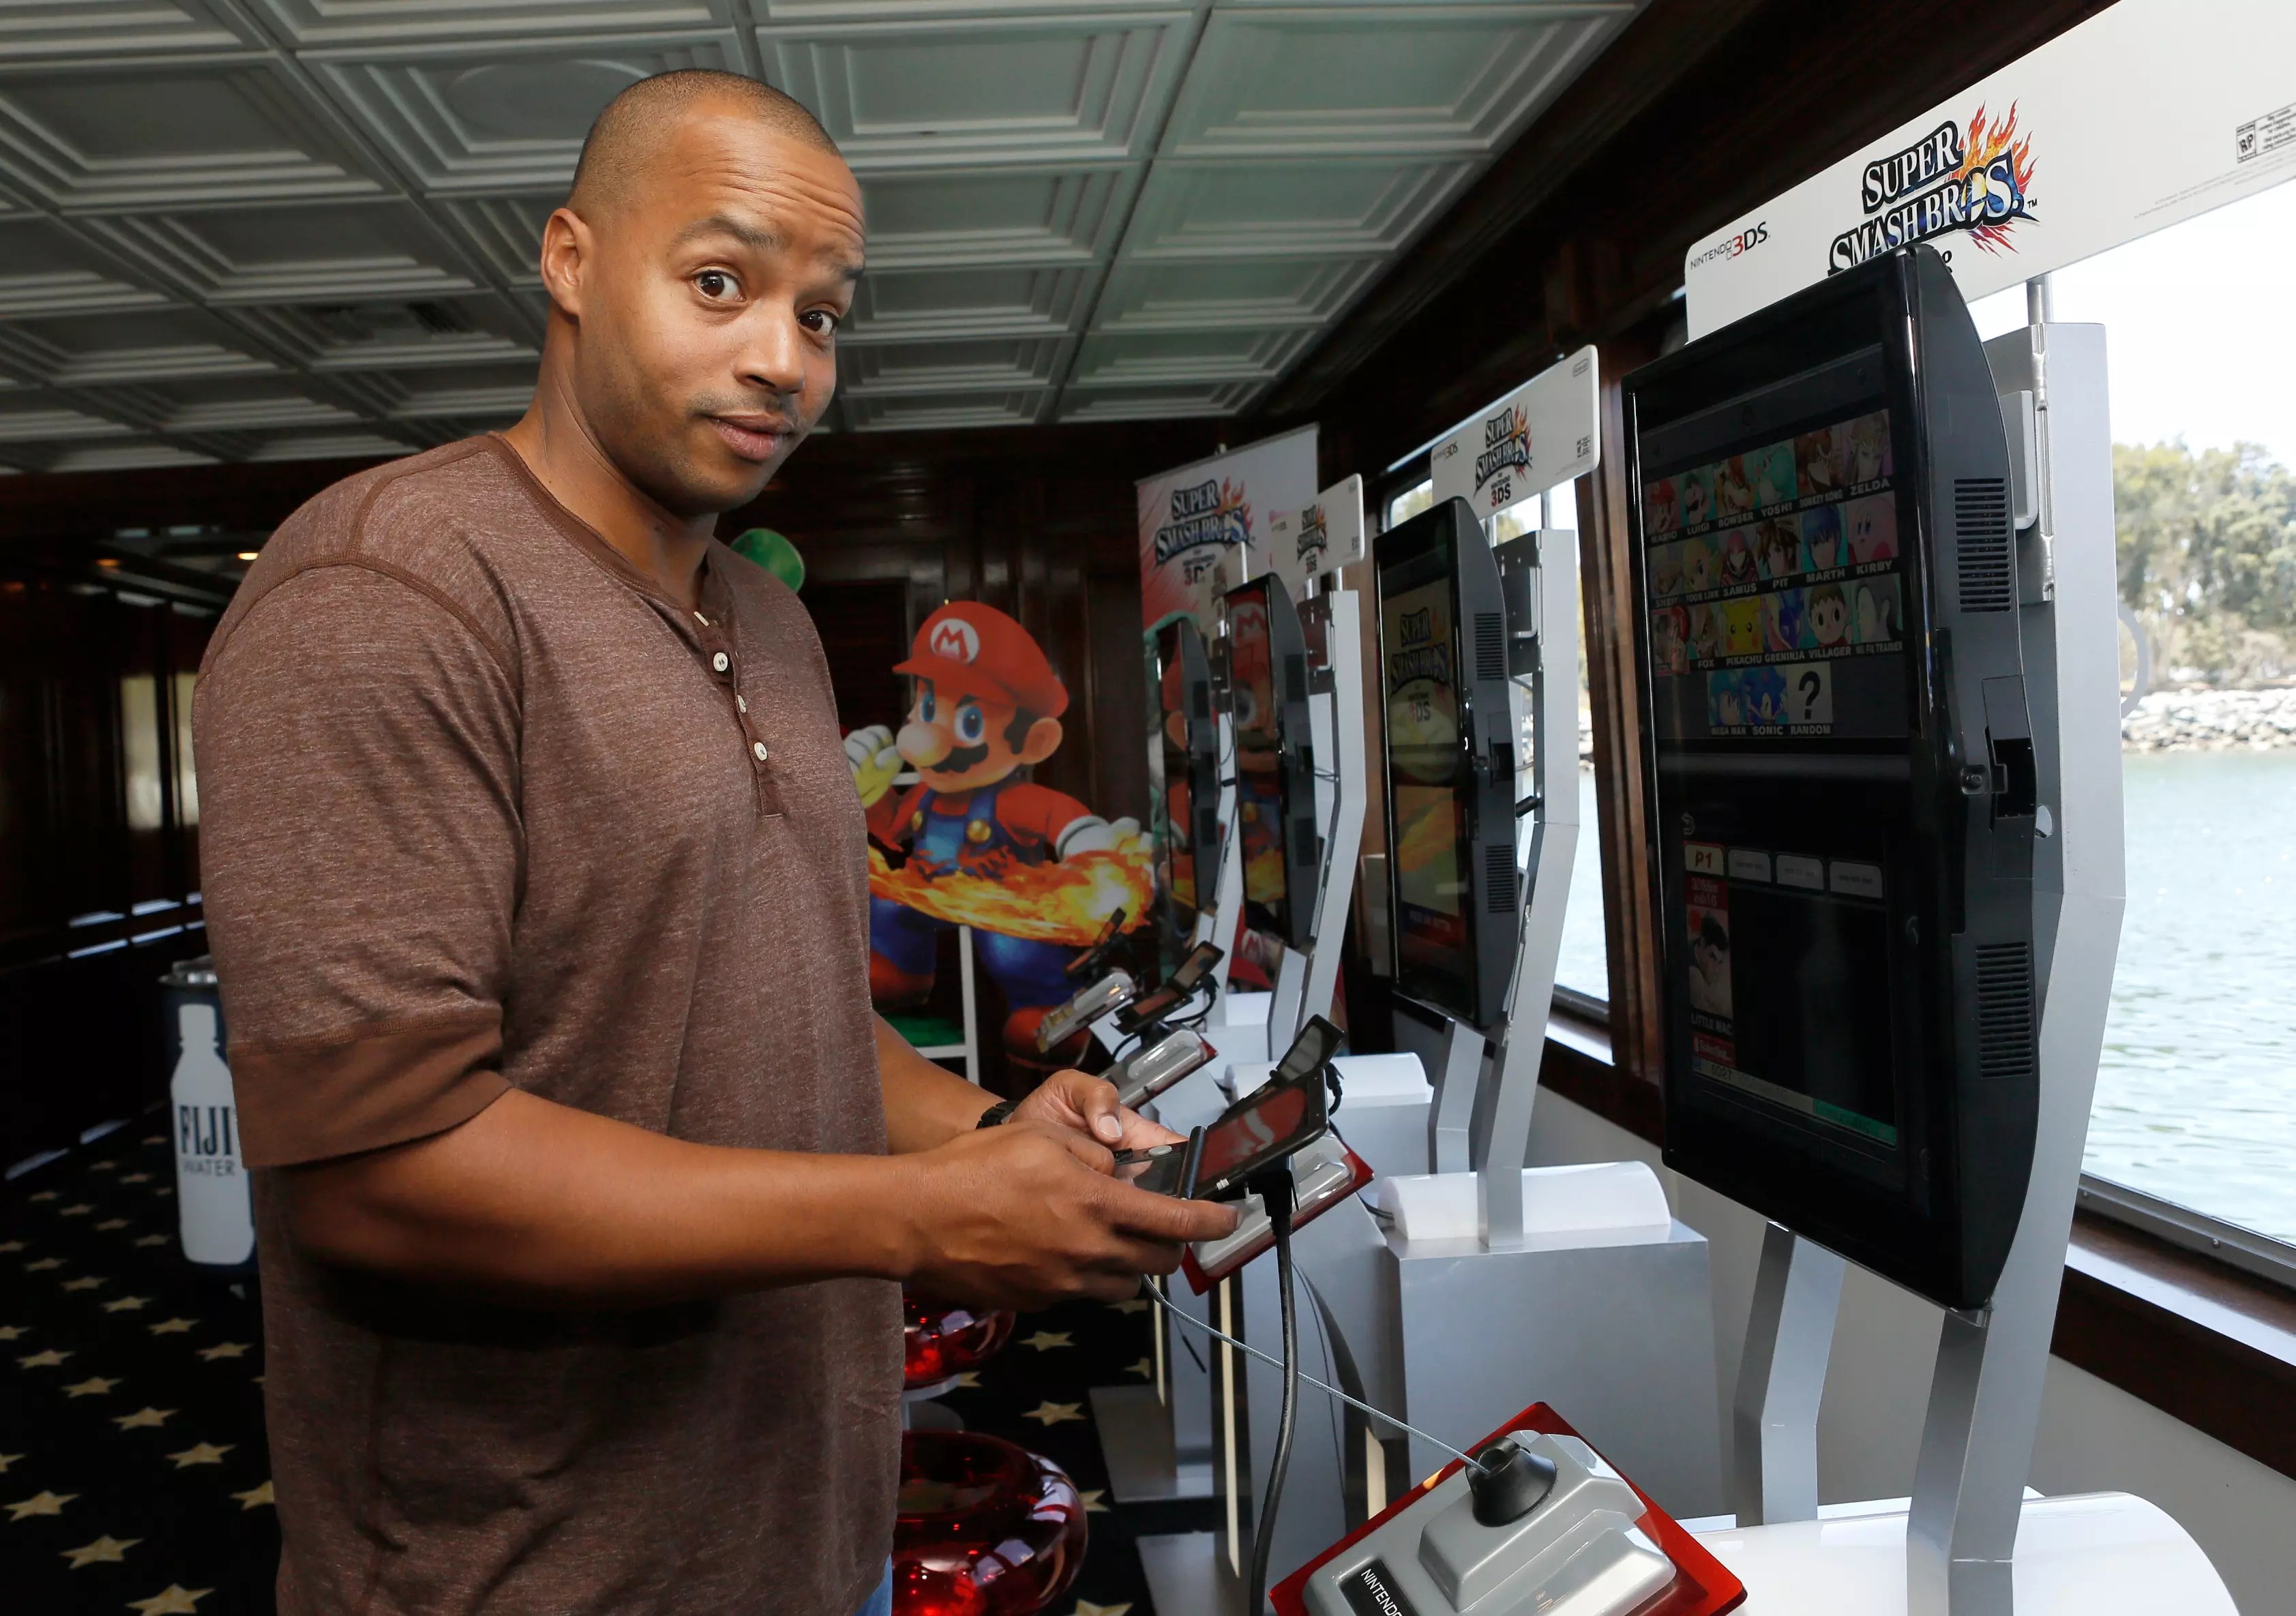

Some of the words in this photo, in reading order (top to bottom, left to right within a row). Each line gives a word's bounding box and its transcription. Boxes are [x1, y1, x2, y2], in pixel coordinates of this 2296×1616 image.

[1862, 122, 1963, 213] SUPER
[1830, 200, 1922, 271] SMASH
[1690, 239, 1732, 270] NINTENDO
[1486, 408, 1513, 449] SUPER
[1475, 446, 1502, 490] SMASH
[1491, 483, 1511, 507] 3DS
[1849, 478, 1891, 496] ZELDA
[1172, 479, 1220, 520] SUPER
[1760, 501, 1793, 518] YOSHI
[1718, 511, 1754, 528] BOWSER
[1686, 522, 1710, 535] LUIGI
[1155, 519, 1201, 564] SMASH
[1806, 569, 1846, 583] MARTH
[1855, 560, 1893, 575] KIRBY
[1723, 582, 1757, 597] SAMUS
[1772, 577, 1789, 589] PIT
[1726, 654, 1762, 667] PIKACHU
[1764, 648, 1805, 663] GRENINJA
[1808, 646, 1851, 659] VILLAGER
[1697, 658, 1715, 670] FOX
[1752, 725, 1784, 736] SONIC
[1790, 724, 1831, 736] RANDOM
[1695, 850, 1713, 869] P1
[179, 1105, 233, 1156] FIJI
[183, 1159, 235, 1178] WATER
